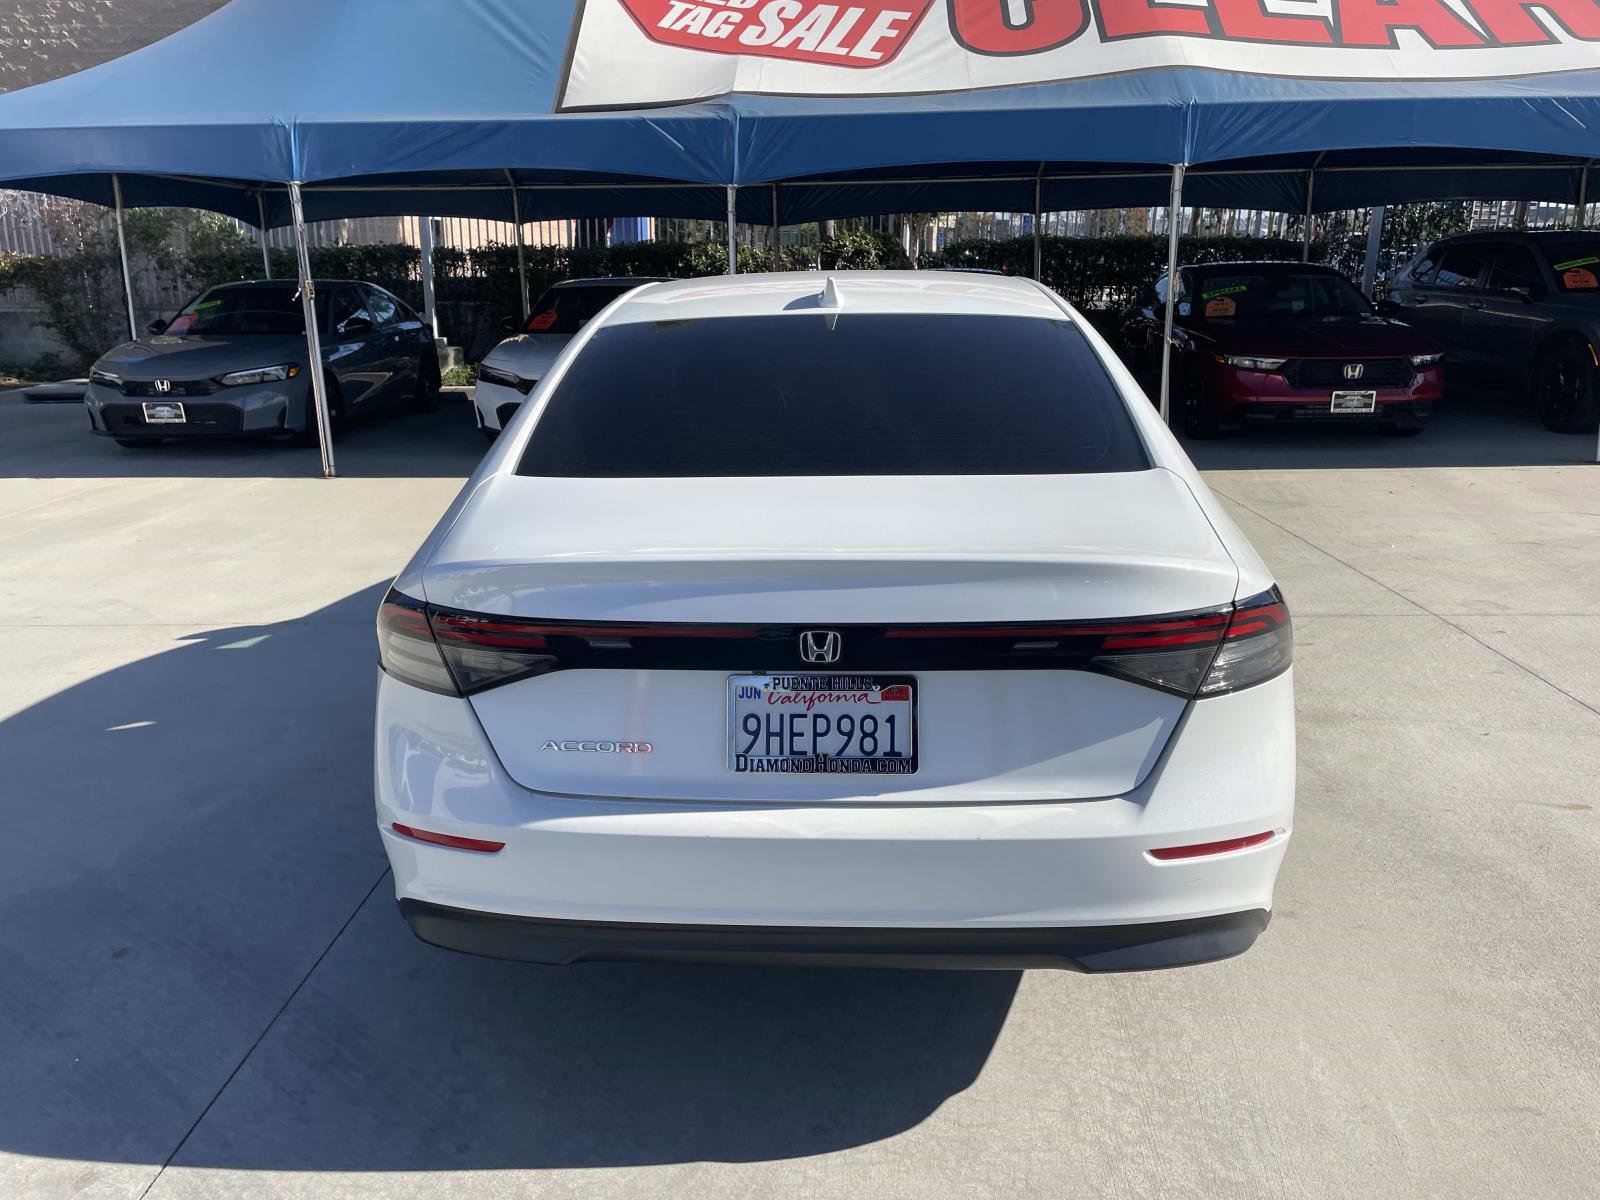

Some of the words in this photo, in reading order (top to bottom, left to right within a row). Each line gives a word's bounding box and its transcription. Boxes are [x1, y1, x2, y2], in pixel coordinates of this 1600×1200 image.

[656, 0, 744, 39] TAG
[738, 0, 912, 60] SALE
[772, 676, 829, 690] PUENTE
[832, 676, 873, 690] HILLS
[738, 686, 761, 700] JUN
[767, 691, 881, 711] California
[742, 713, 903, 757] 9HEP981
[540, 740, 654, 753] ACCORD
